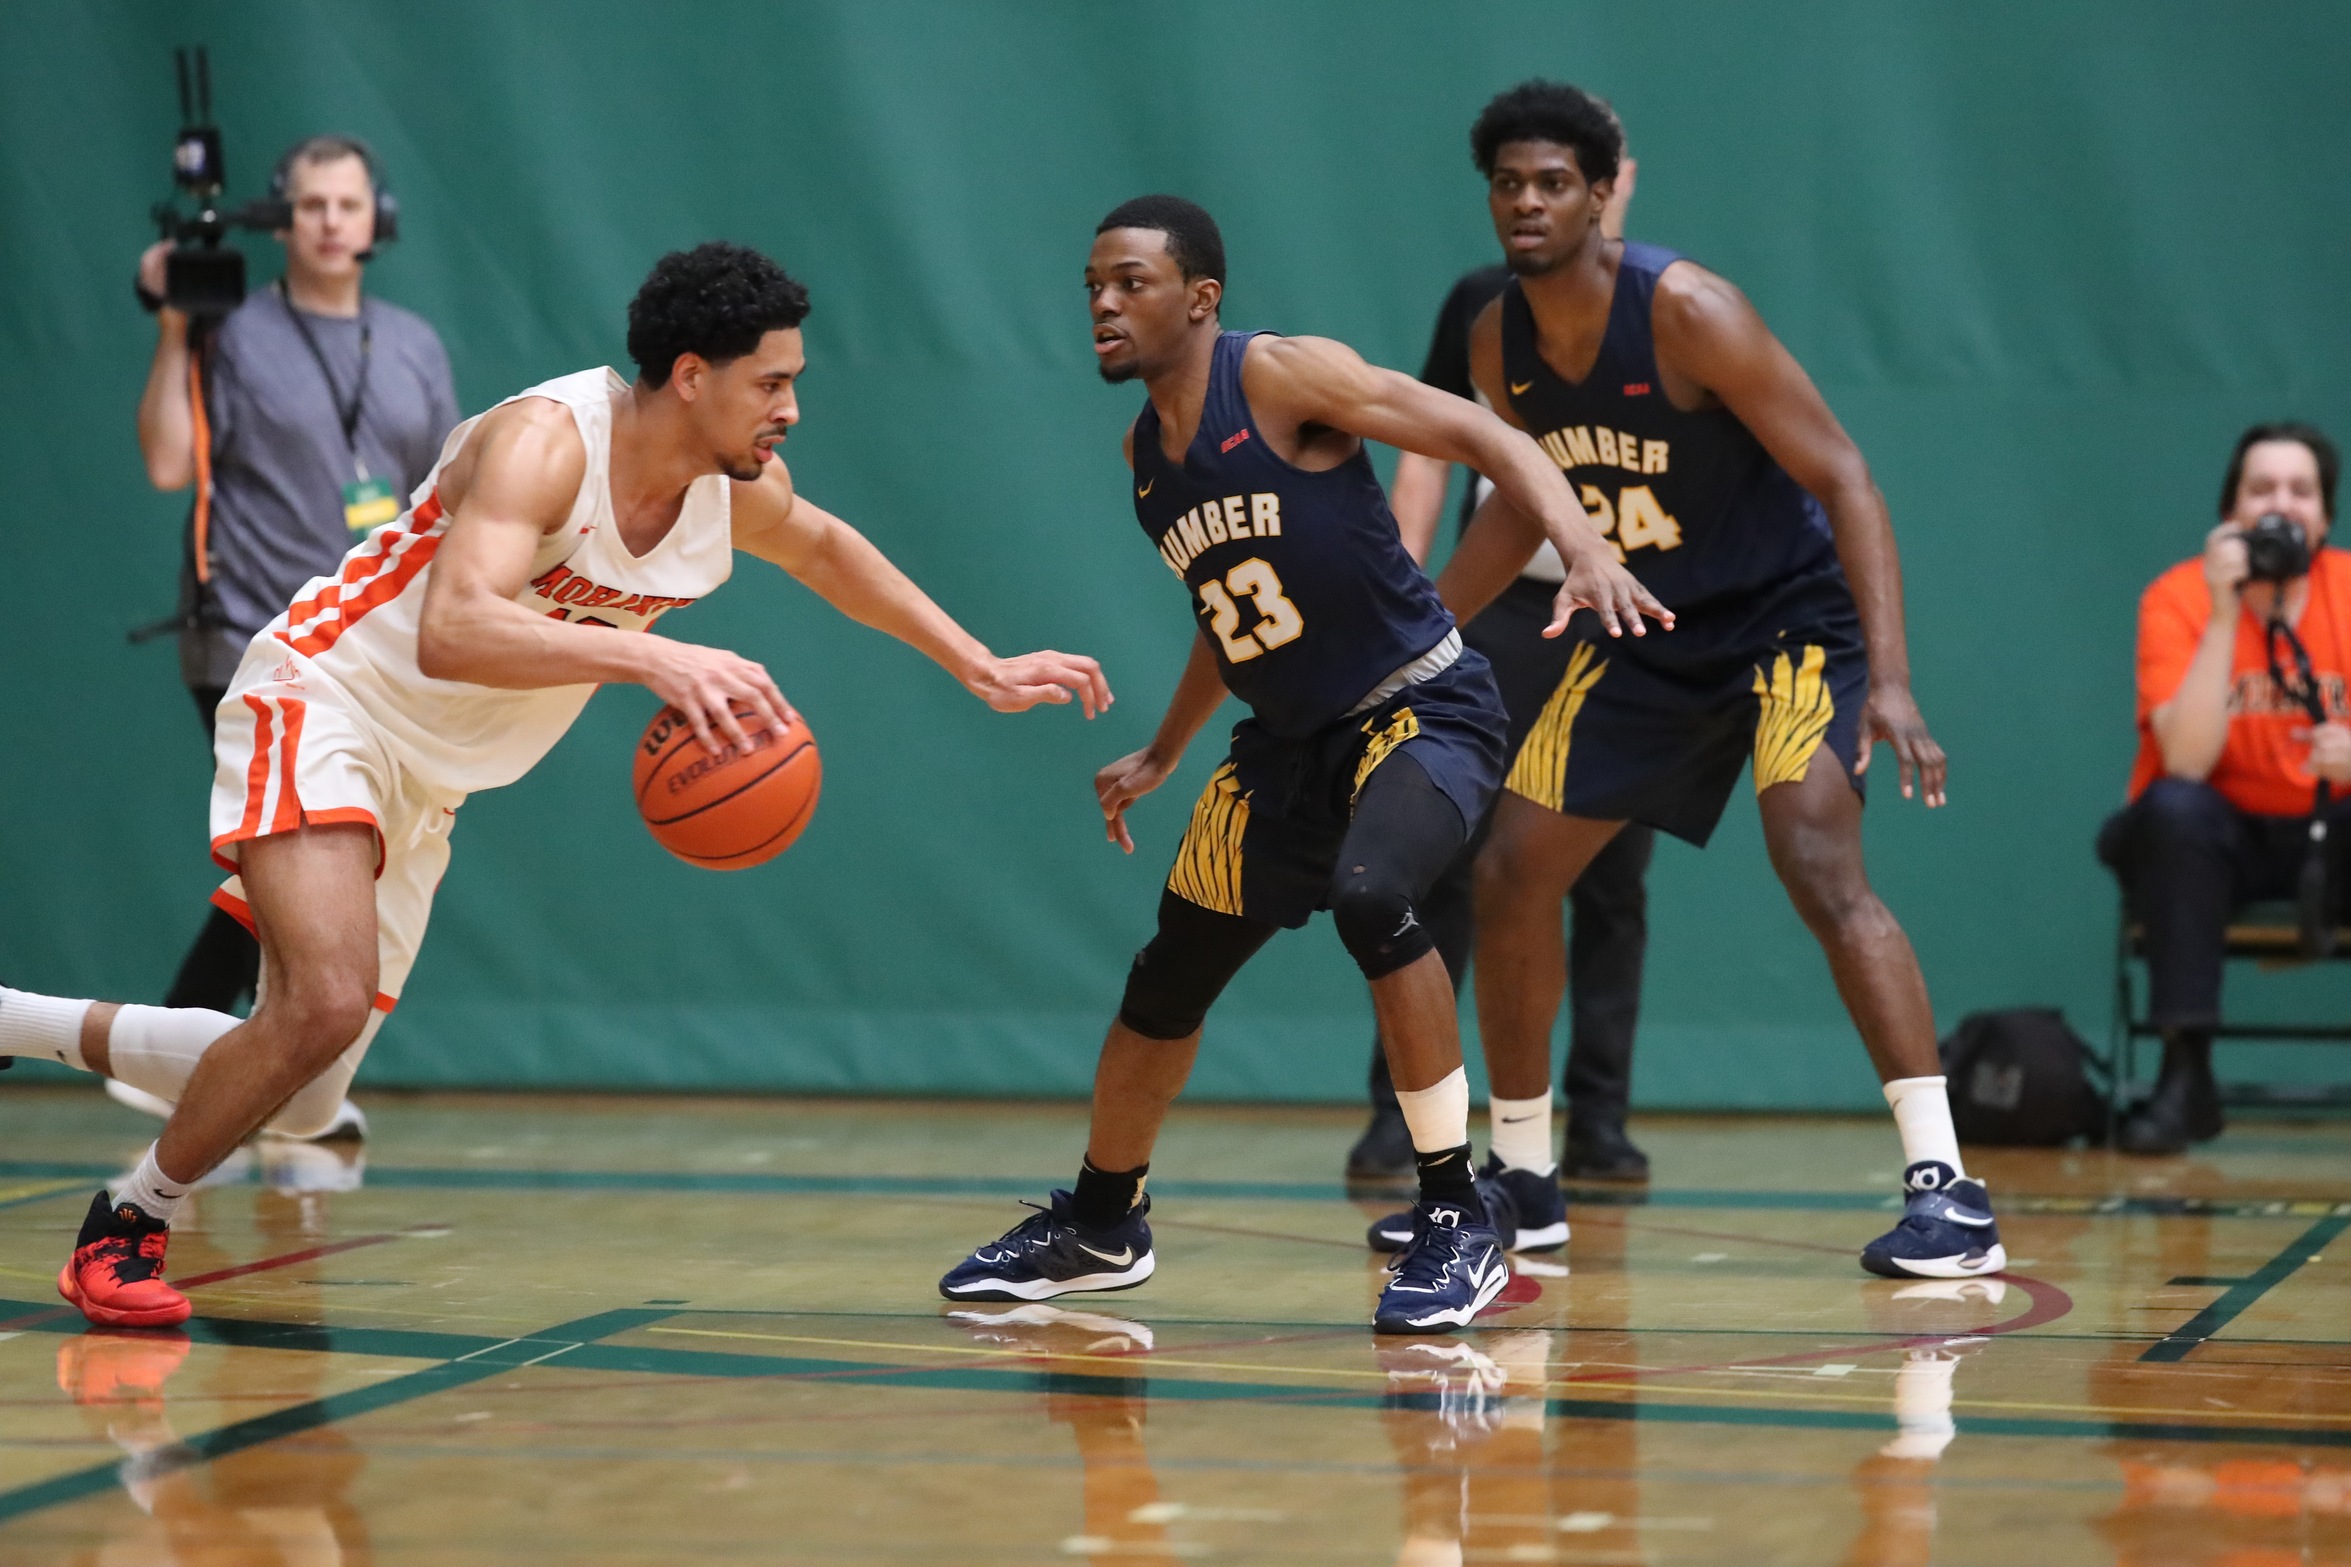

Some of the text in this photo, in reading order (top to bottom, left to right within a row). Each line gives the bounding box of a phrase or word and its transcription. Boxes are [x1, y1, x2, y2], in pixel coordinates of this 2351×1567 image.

[1580, 484, 1684, 565] 24
[530, 561, 698, 617] MOHA
[1199, 557, 1304, 664] 23
[668, 728, 775, 794] EVOLUTN
